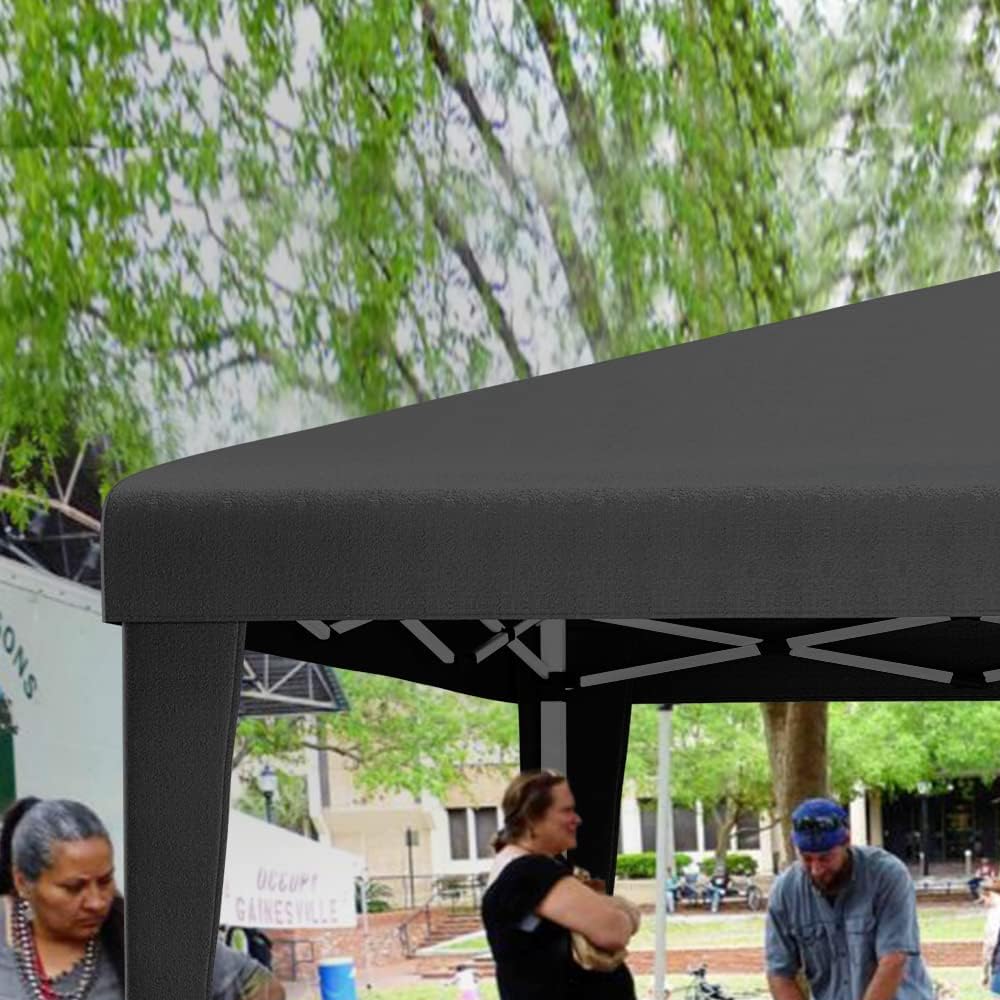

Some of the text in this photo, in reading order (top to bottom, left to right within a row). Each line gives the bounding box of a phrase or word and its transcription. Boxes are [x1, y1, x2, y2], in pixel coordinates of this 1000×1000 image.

[0, 624, 38, 700] ONS
[256, 868, 319, 893] OCCUPY
[235, 897, 338, 924] GAINESVILLE
